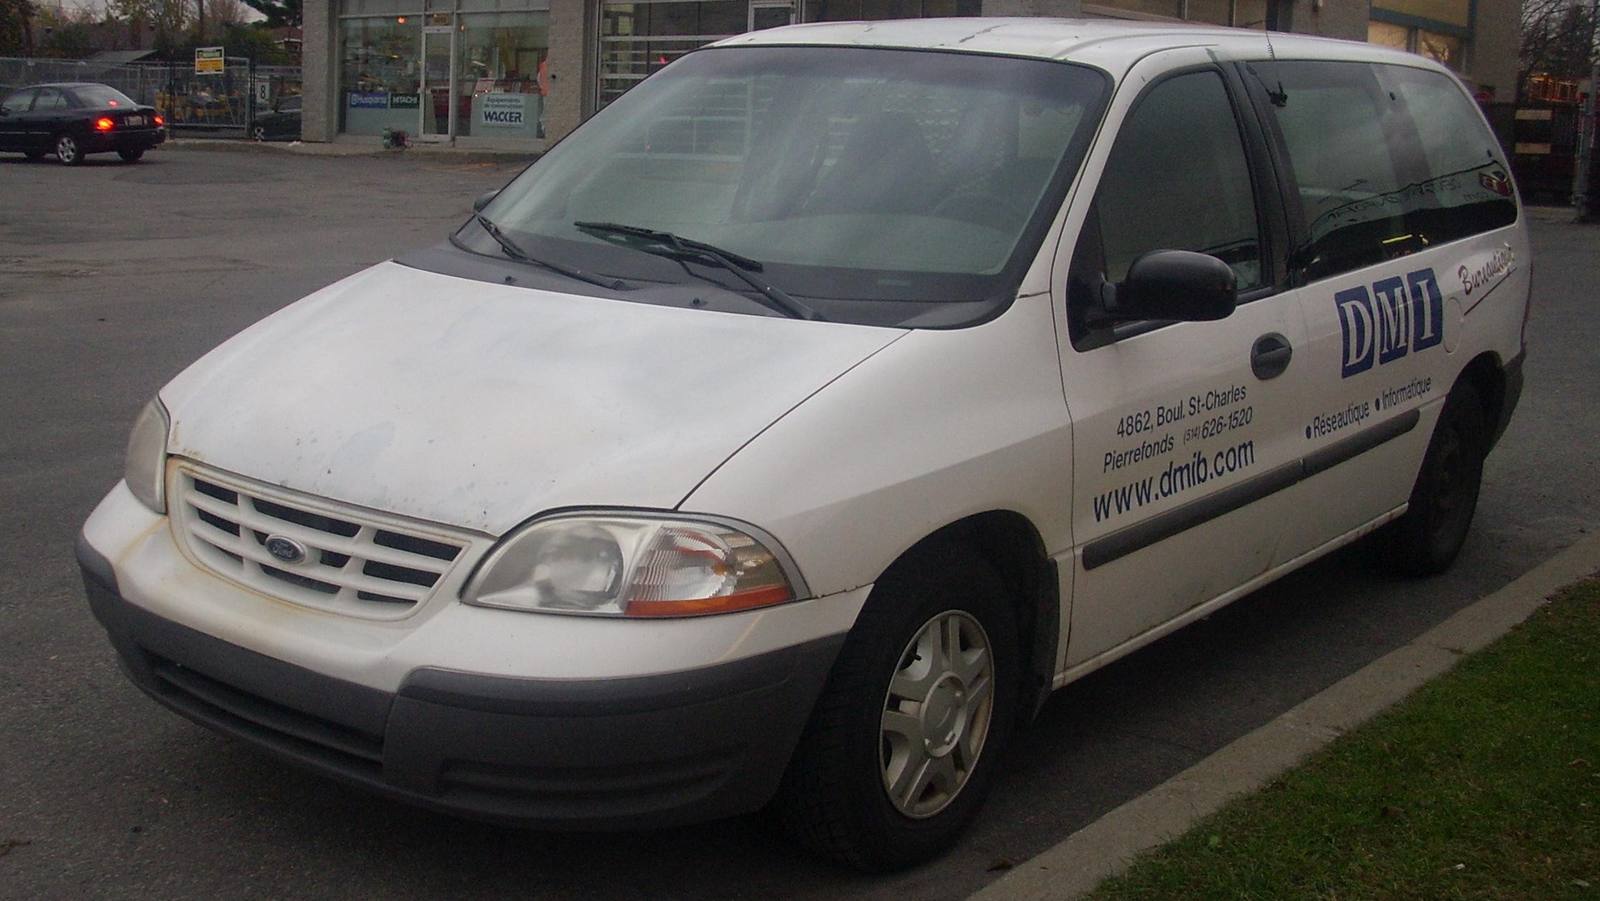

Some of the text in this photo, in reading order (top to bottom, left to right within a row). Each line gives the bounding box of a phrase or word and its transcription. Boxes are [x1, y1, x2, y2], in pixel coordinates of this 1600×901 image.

[484, 111, 522, 122] WACKER
[1339, 276, 1437, 370] DMI
[1116, 384, 1247, 439] 4862, Boul. St-Charles
[1313, 377, 1432, 439] Réseautique Informatique
[1093, 439, 1255, 523] www.dmib.com
[1103, 433, 1175, 473] Pierrefonds
